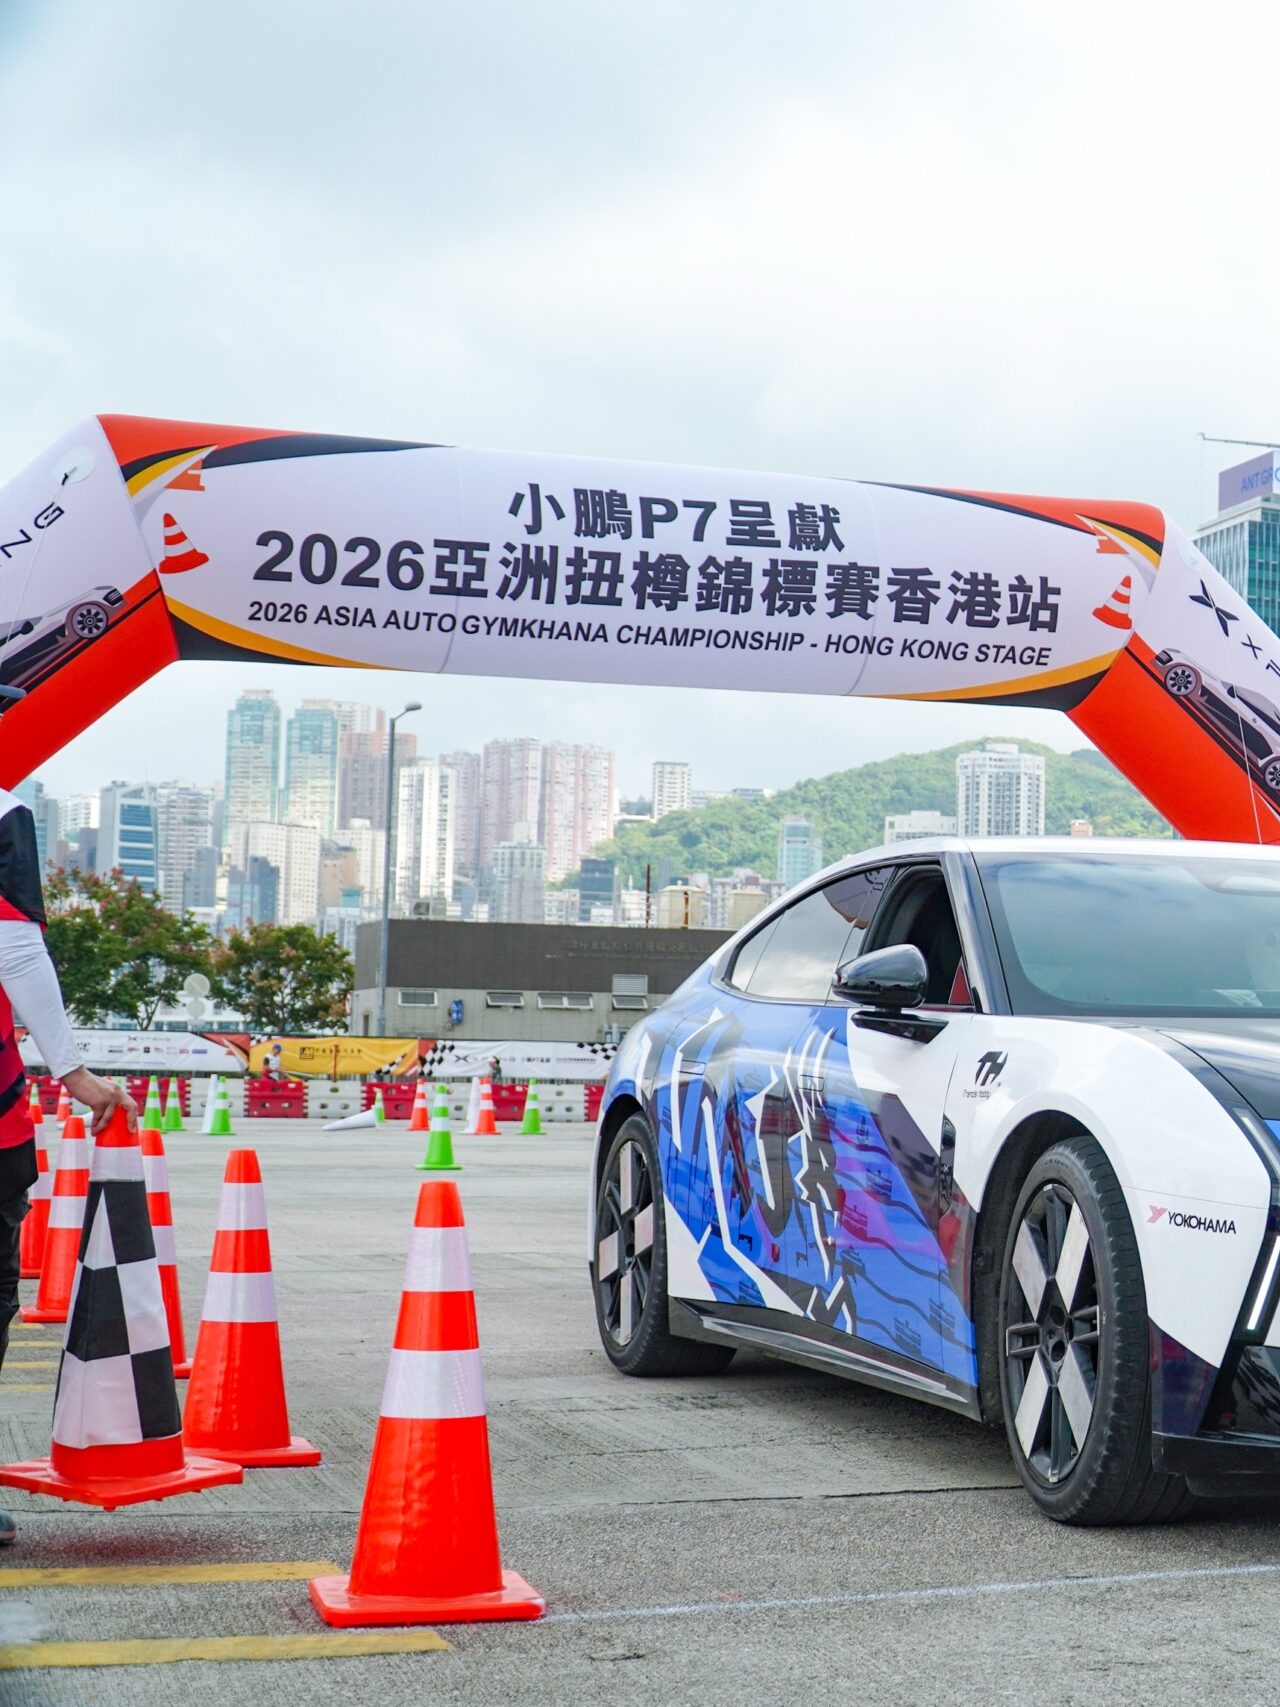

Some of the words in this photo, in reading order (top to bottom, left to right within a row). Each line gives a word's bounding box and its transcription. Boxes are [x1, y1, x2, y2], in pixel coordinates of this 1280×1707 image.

[508, 482, 846, 552] 小鵬P7呈獻
[252, 529, 1062, 633] 2026亞洲扭樽錦標賽香港站
[248, 601, 308, 623] 2026
[314, 605, 377, 628] ASIA
[383, 610, 457, 632] AUTO
[461, 614, 609, 643] GYMKHANA
[616, 624, 804, 652] CHAMPIONSHIP
[824, 634, 894, 656] HONG
[899, 638, 969, 662] KONG
[975, 643, 1053, 666] STAGE
[1168, 1211, 1237, 1234] YOKOHAMA
